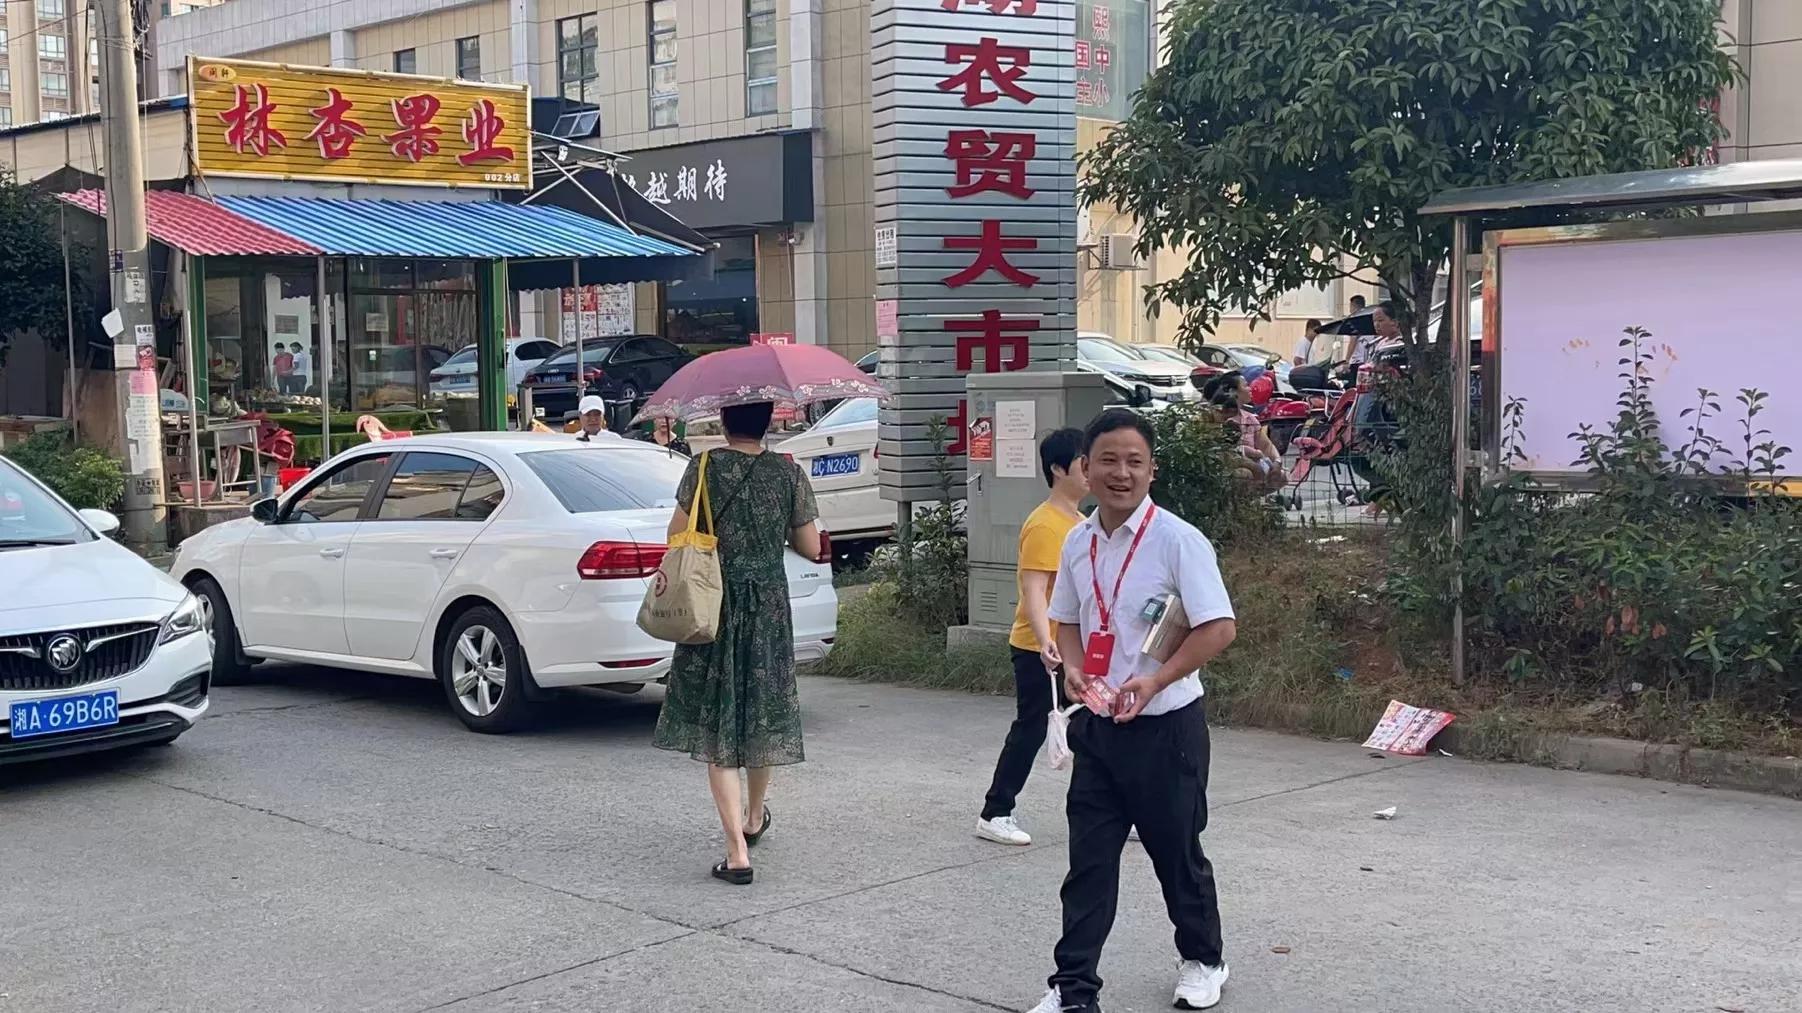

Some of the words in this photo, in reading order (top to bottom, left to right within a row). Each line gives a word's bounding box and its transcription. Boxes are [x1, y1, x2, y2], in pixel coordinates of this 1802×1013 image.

[217, 83, 514, 166] 林杏果业
[621, 159, 728, 204] 越期待
[935, 0, 1041, 456] 农贸大市
[14, 696, 116, 732] 湘A·69B6R
